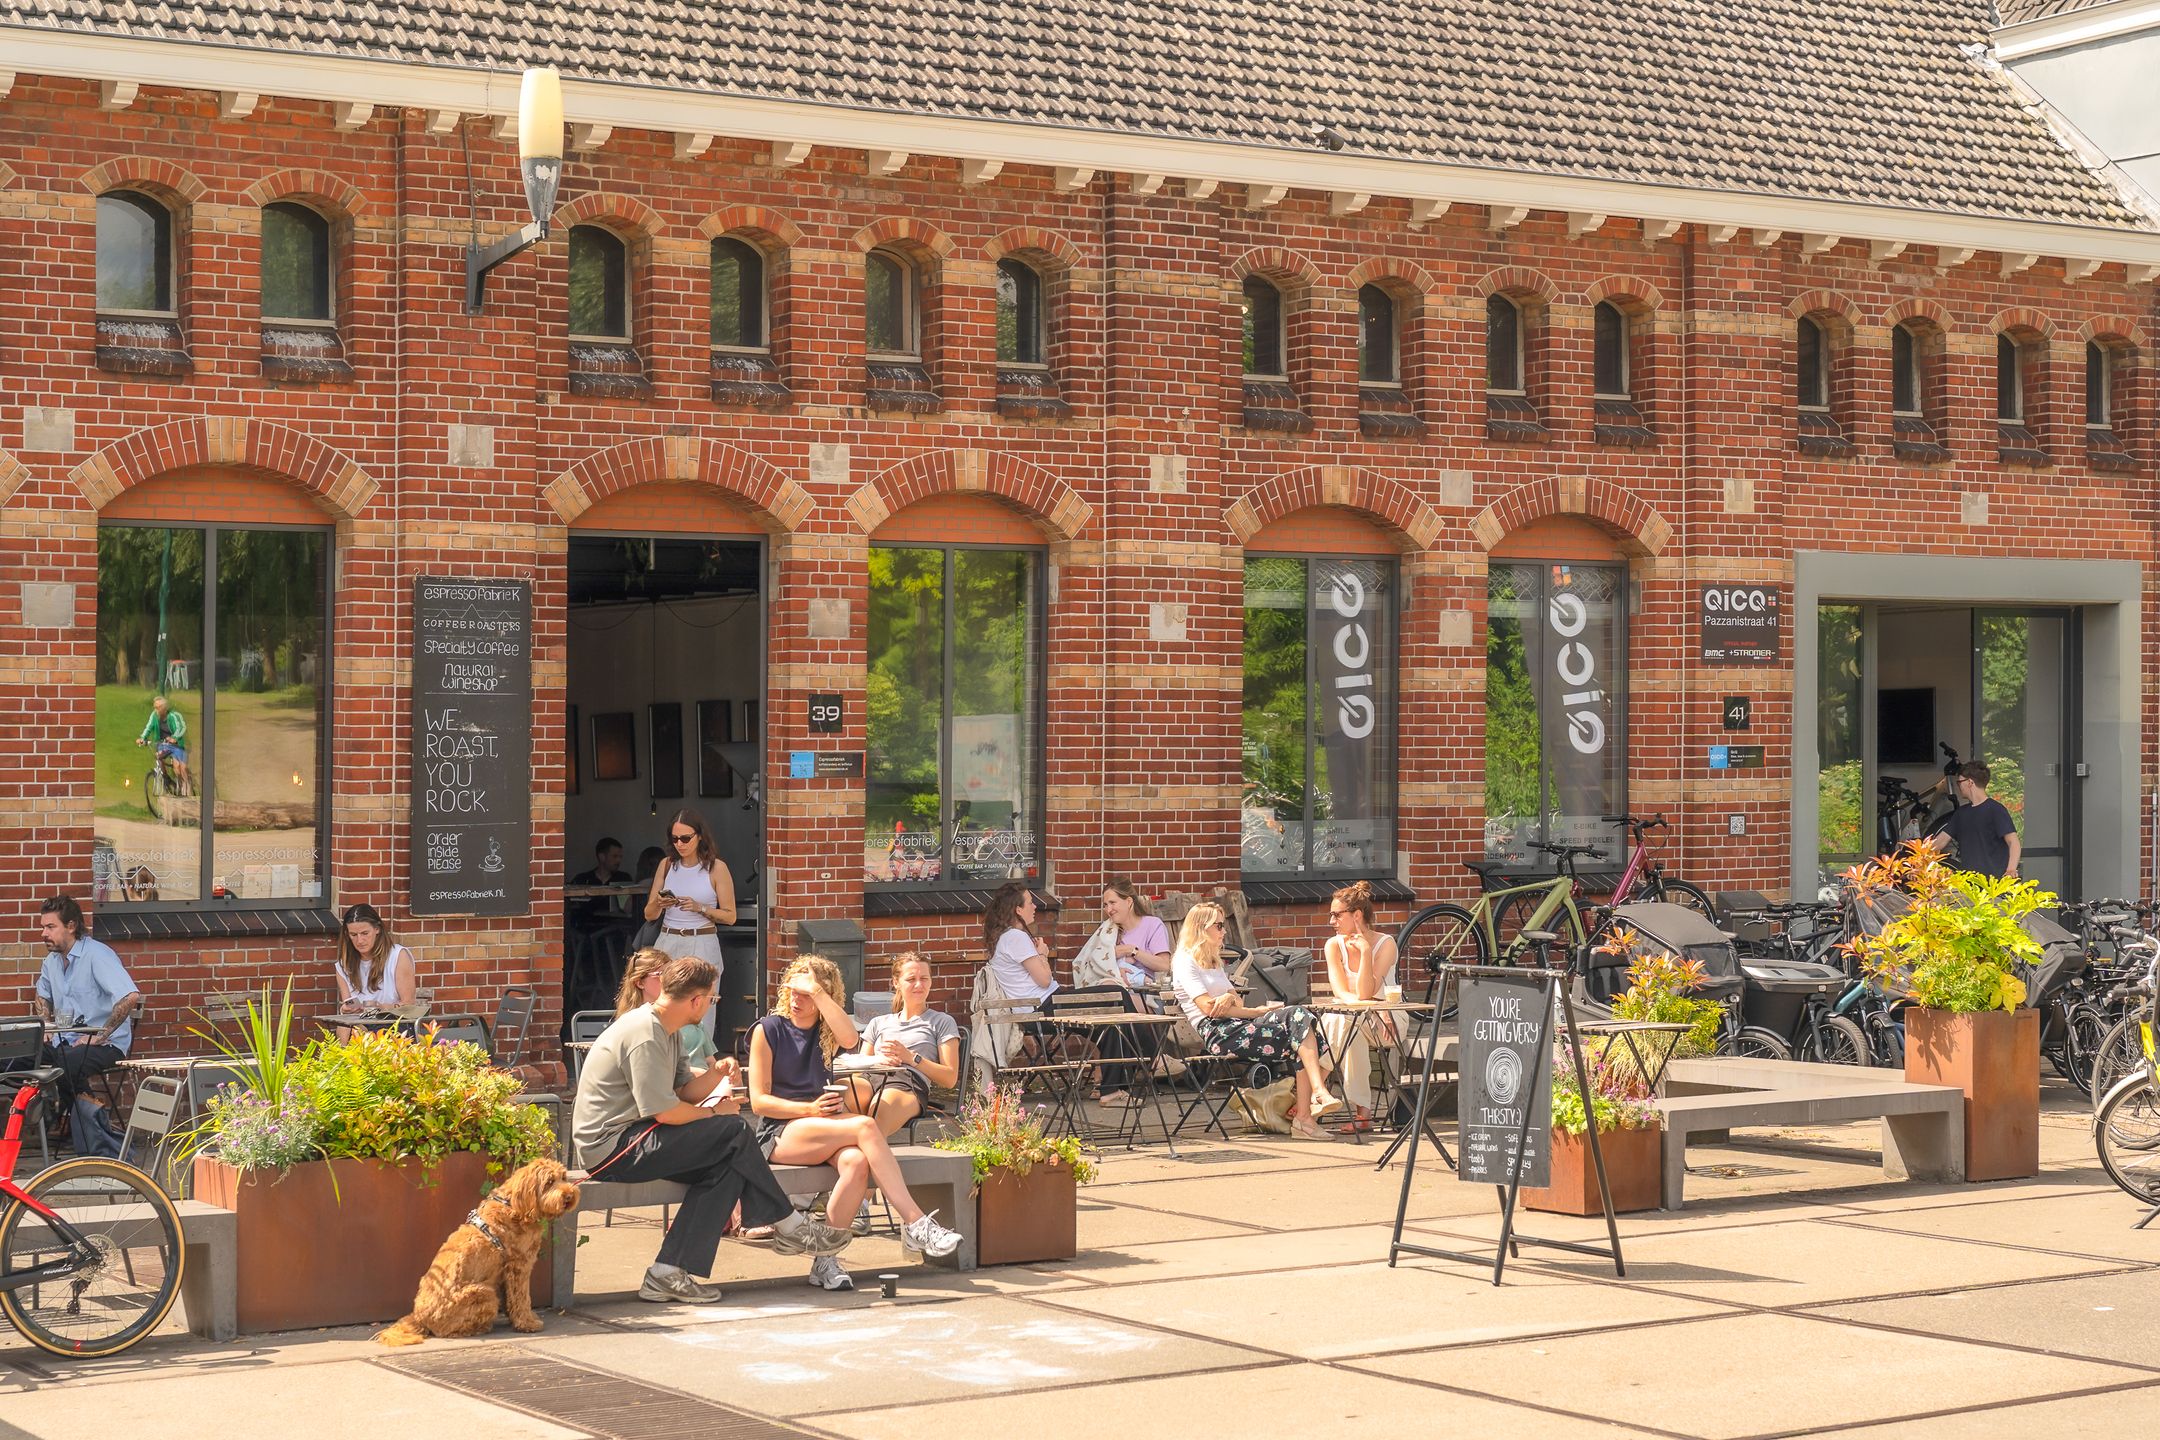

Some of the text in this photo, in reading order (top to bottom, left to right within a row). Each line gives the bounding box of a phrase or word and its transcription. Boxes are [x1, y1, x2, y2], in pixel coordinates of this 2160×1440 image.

[423, 619, 521, 631] COFFEE ROASTERS
[1704, 615, 1777, 627] Pazzanistraat 41
[424, 708, 458, 731] WE
[812, 705, 840, 722] 39
[1728, 706, 1744, 720] 41
[425, 762, 472, 787] YOU
[955, 833, 1036, 847] espressofabriek
[1474, 1019, 1539, 1044] GETTING VERY
